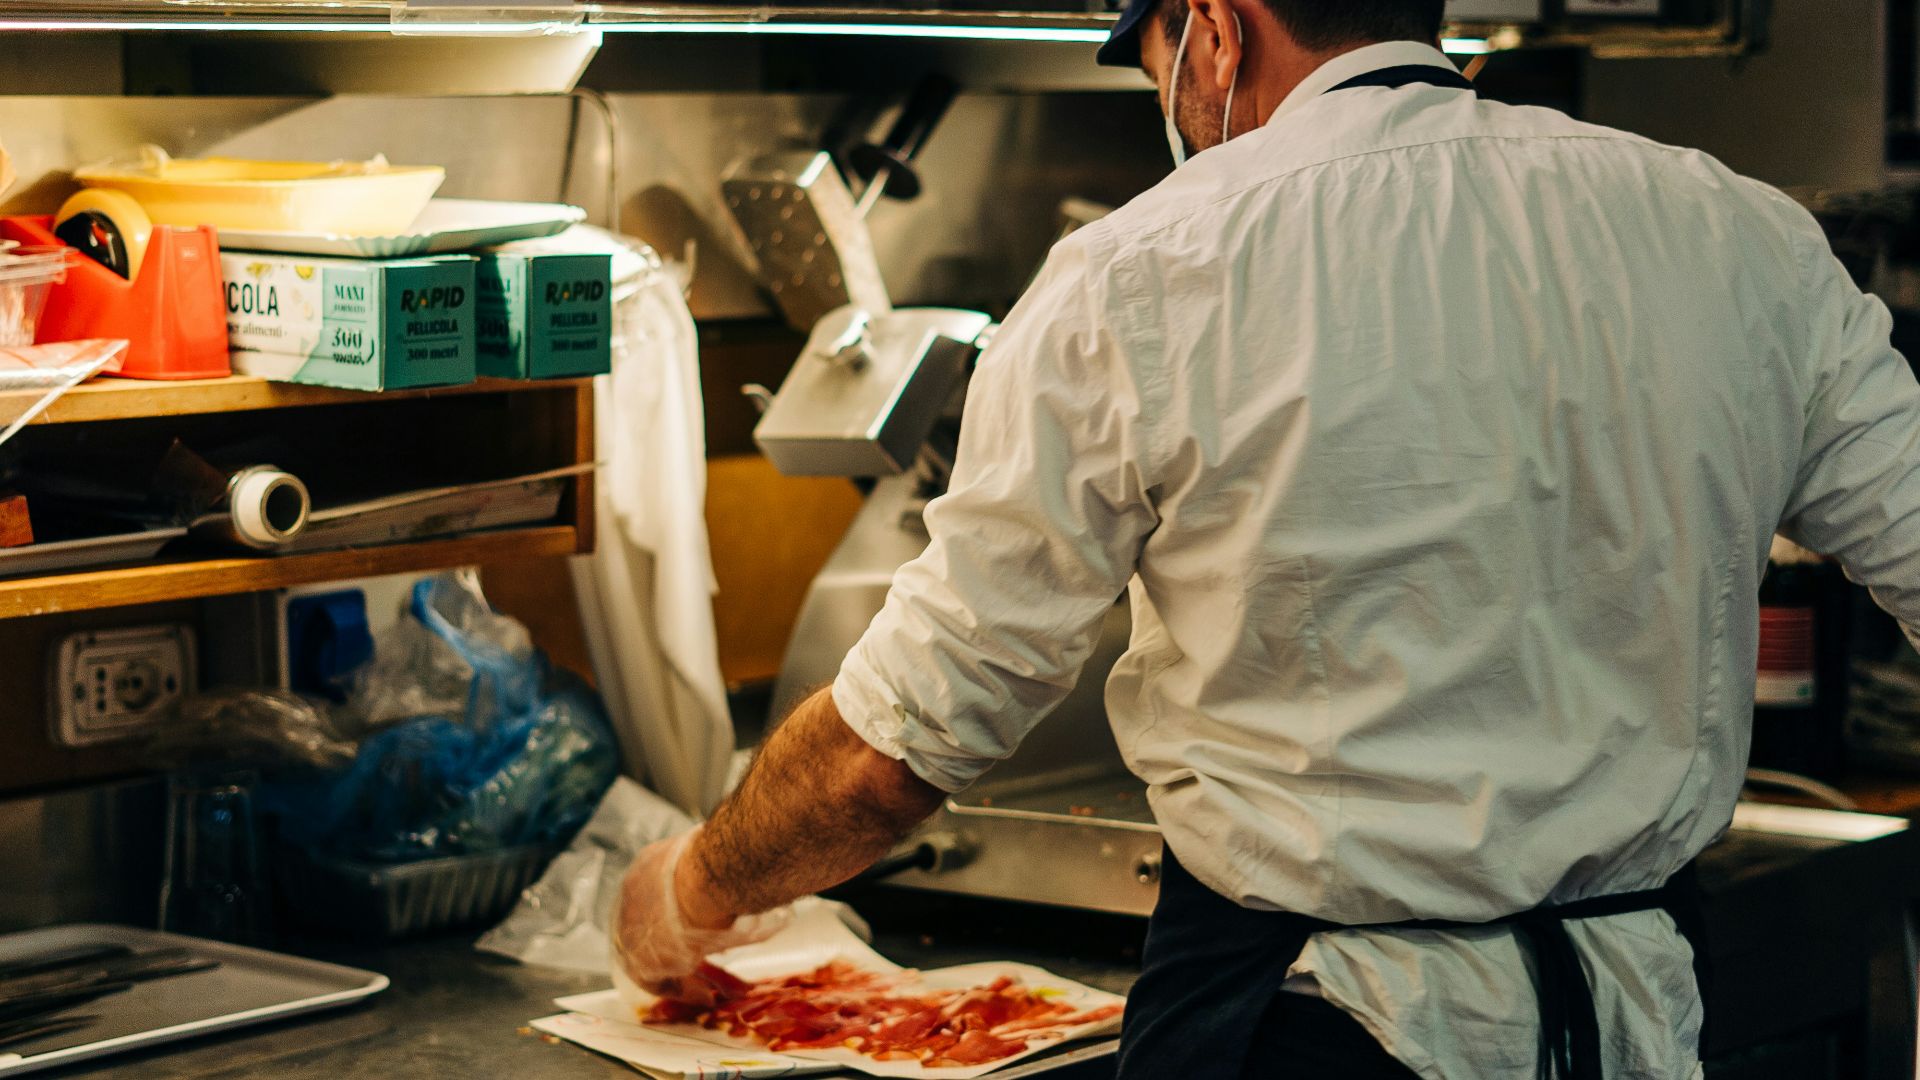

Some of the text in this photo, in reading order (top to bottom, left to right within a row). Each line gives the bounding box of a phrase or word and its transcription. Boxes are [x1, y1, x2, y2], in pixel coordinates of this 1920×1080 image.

[335, 284, 365, 301] MAXI
[400, 286, 465, 313] RAPID
[545, 280, 604, 305] RAPID
[407, 319, 459, 336] PELLICOLA
[550, 311, 598, 327] PELLICOLA
[243, 323, 282, 338] alimenti
[331, 327, 363, 349] 300
[407, 346, 459, 361] 300 metri
